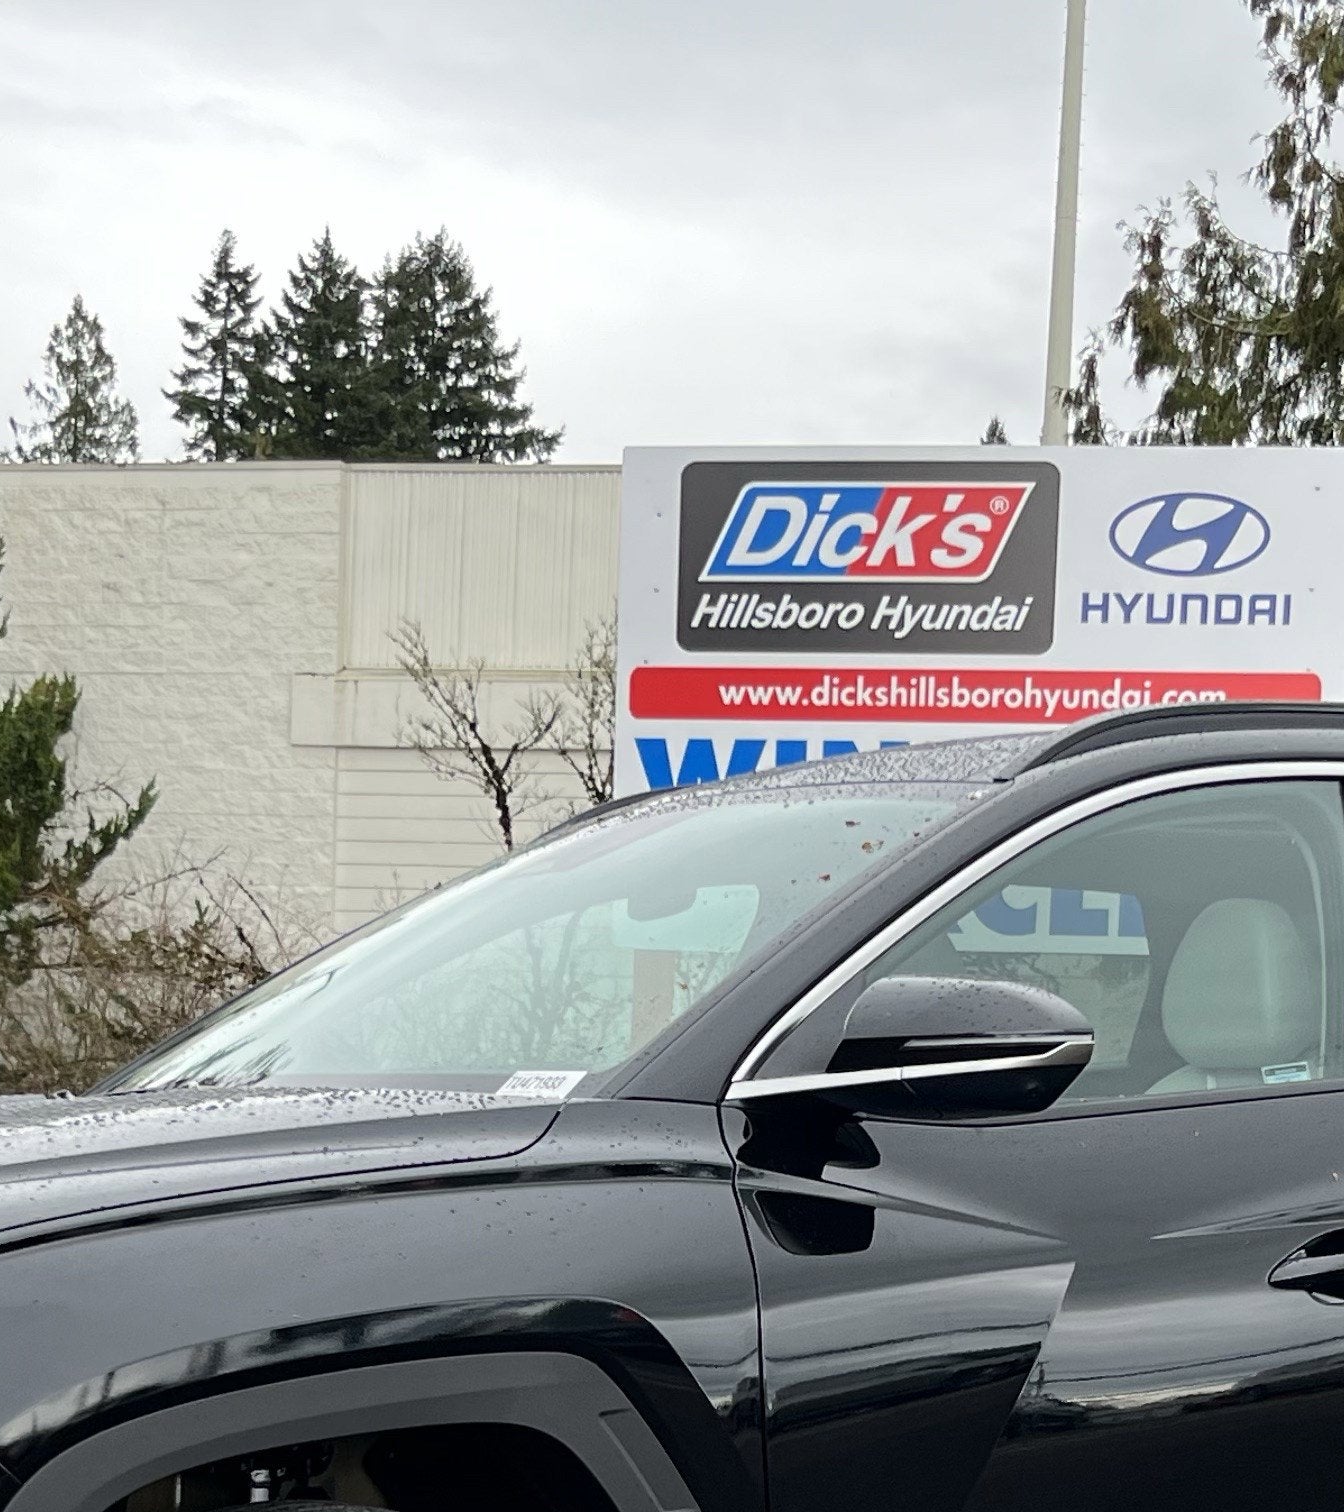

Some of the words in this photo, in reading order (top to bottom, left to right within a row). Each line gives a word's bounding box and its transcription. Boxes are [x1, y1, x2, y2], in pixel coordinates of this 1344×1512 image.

[690, 593, 865, 631] Hillsboro
[870, 595, 1034, 640] Hyundai
[1081, 591, 1291, 626] HYUNDAI
